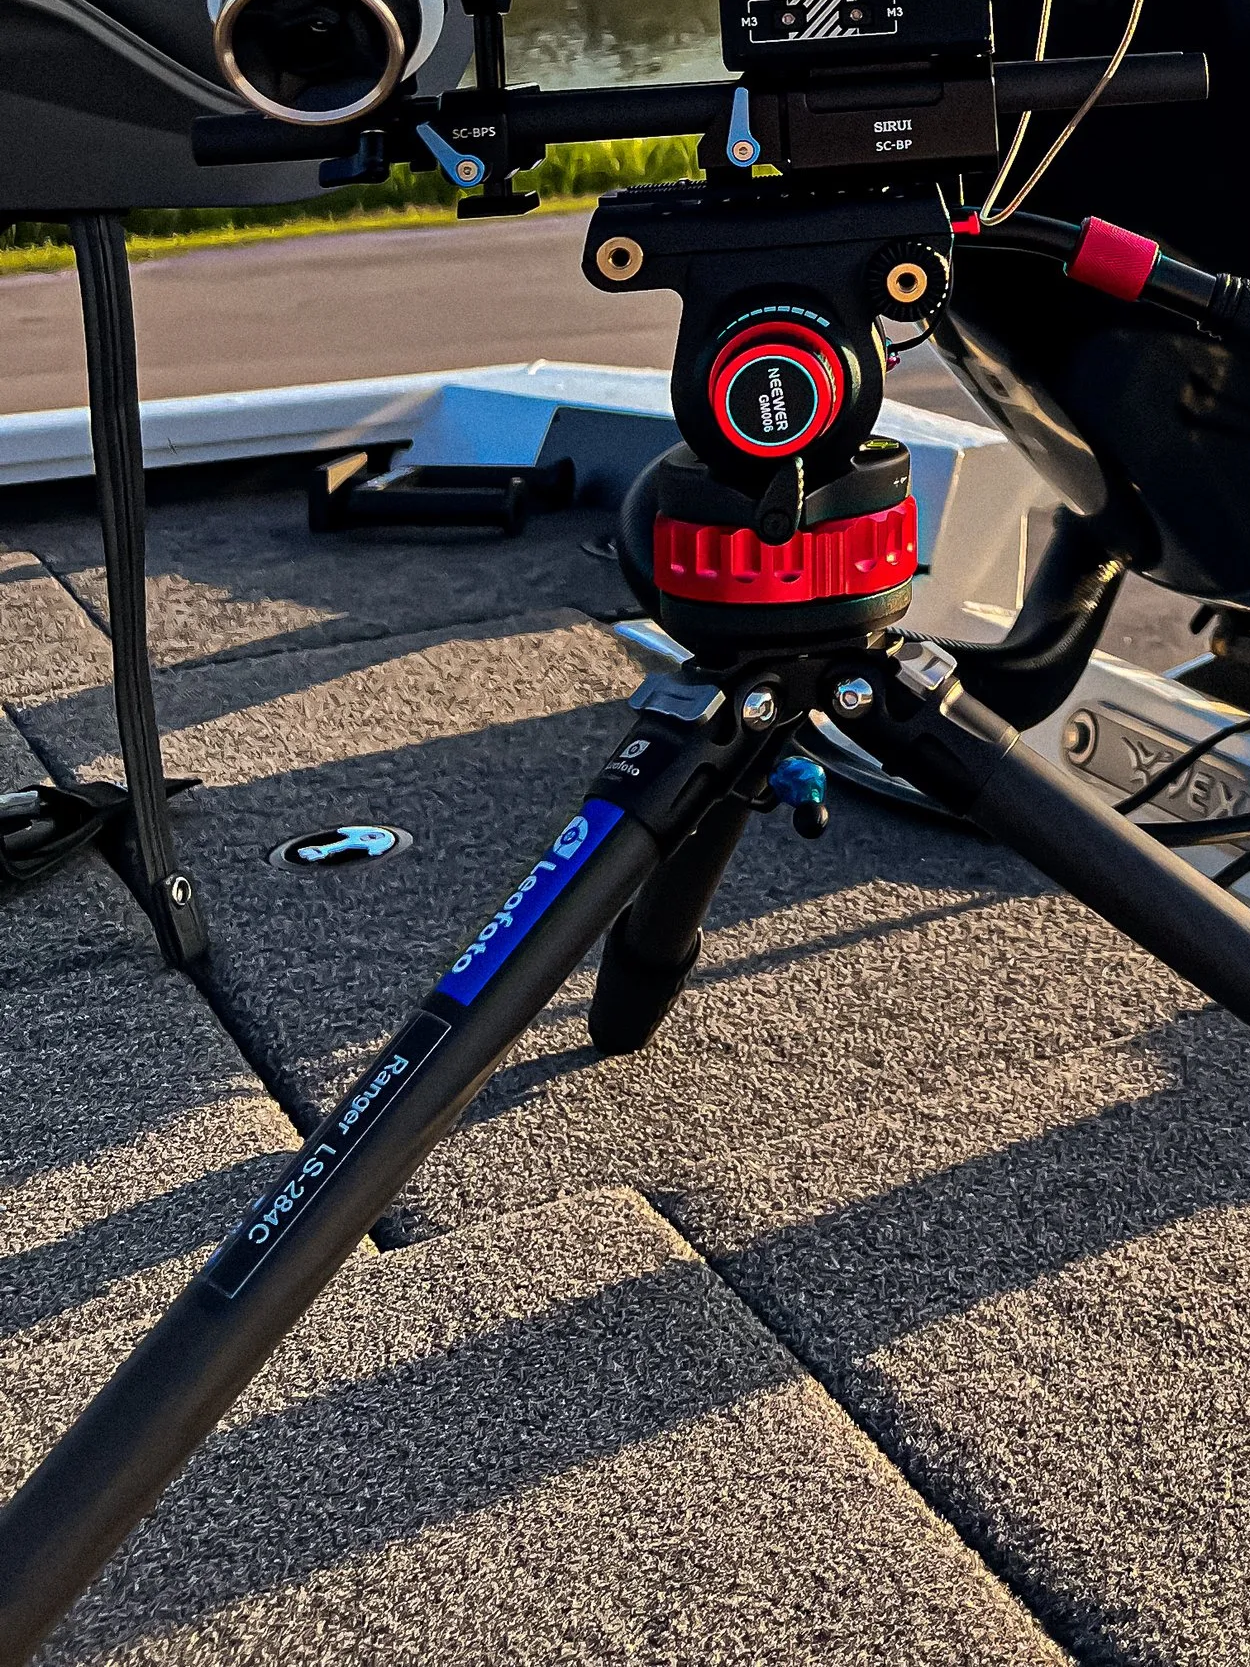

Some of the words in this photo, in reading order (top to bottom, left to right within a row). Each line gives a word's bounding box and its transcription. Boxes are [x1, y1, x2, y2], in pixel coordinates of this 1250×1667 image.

[741, 15, 758, 27] M3
[887, 6, 903, 18] M3
[452, 126, 496, 139] SC-BPS
[873, 119, 913, 133] SIRUI
[875, 139, 913, 152] SC-BP
[767, 367, 789, 432] NEEWER
[758, 394, 774, 433] GM006
[452, 859, 558, 976] Leofoto
[339, 1053, 410, 1136] Ranger
[247, 1142, 338, 1246] LS-284C
